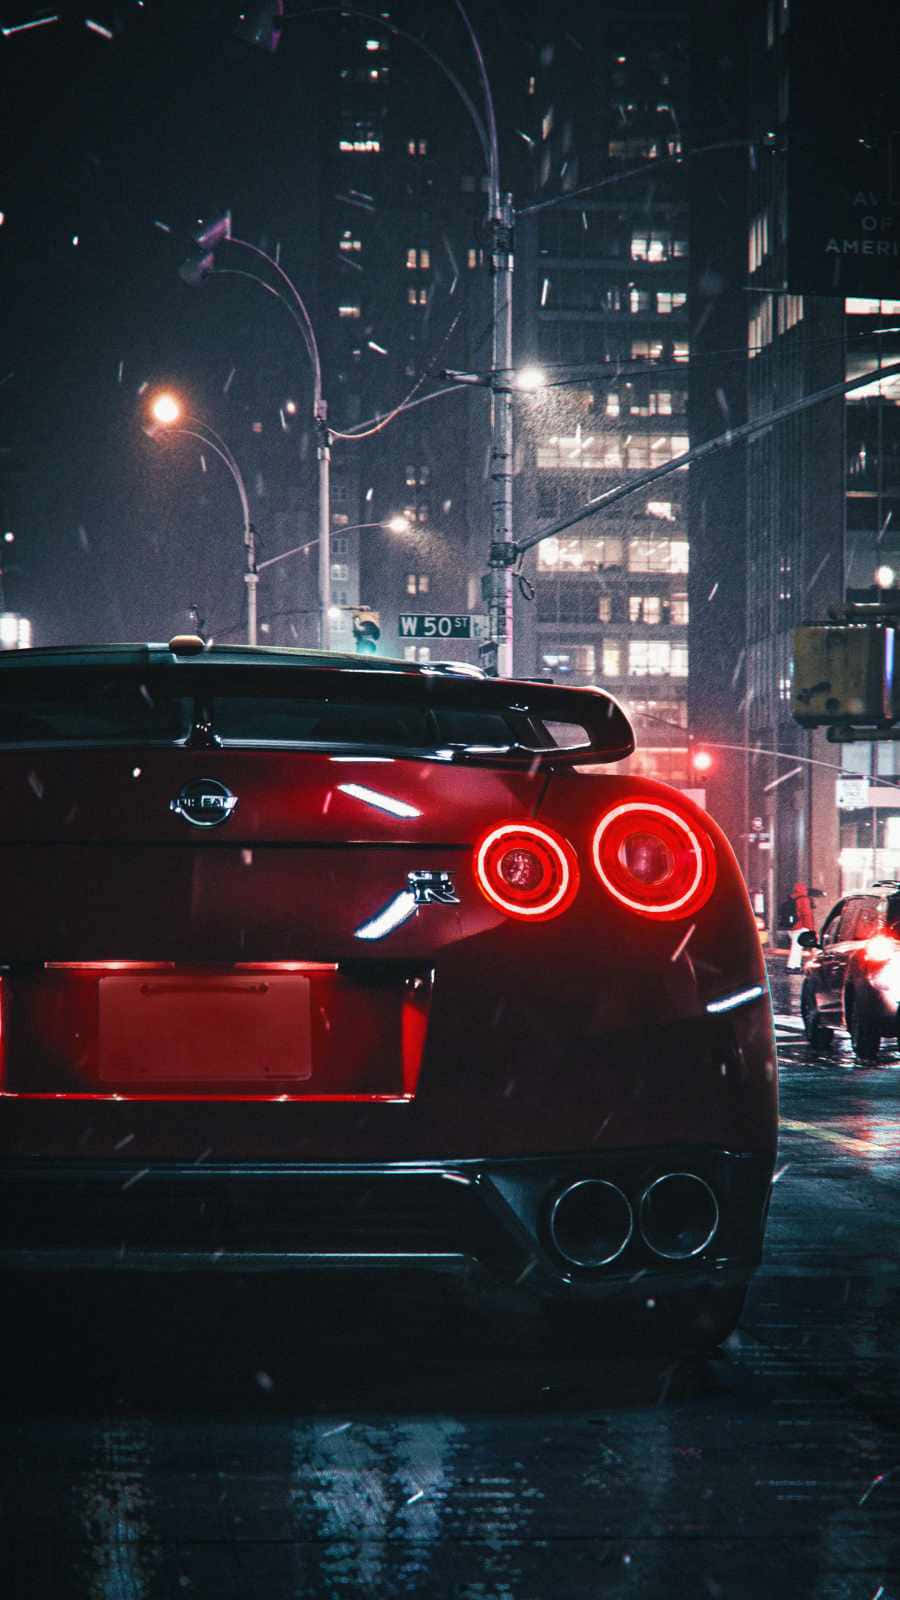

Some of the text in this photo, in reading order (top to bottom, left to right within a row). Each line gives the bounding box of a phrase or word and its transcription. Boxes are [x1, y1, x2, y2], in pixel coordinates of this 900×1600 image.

[401, 616, 468, 636] W 50 ST
